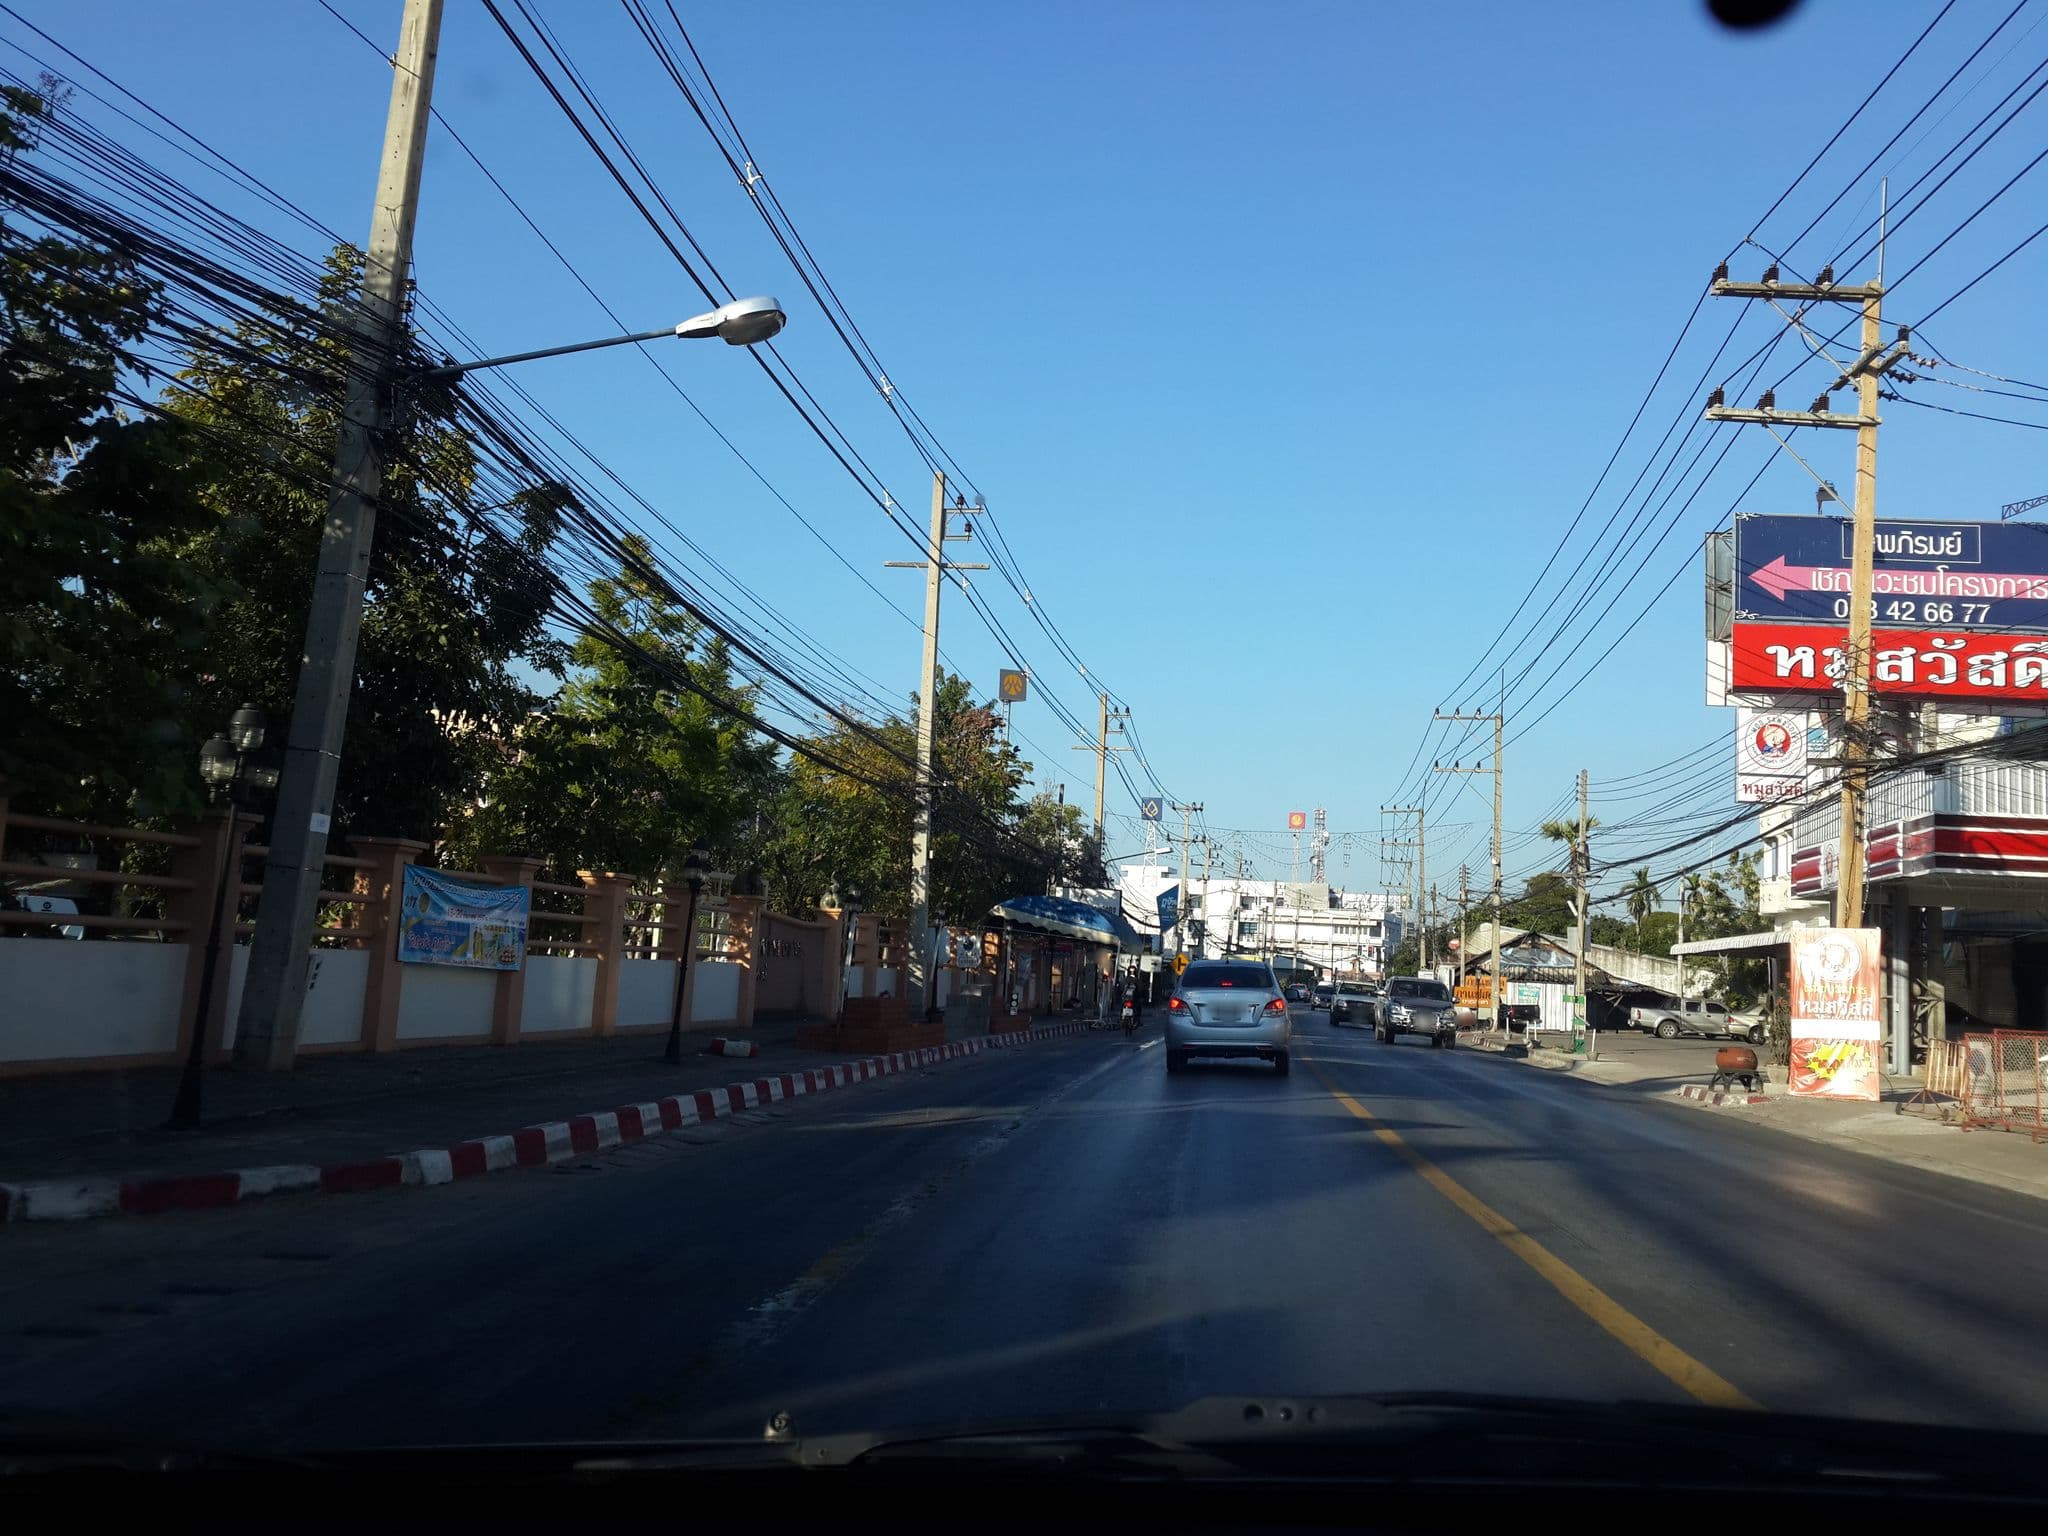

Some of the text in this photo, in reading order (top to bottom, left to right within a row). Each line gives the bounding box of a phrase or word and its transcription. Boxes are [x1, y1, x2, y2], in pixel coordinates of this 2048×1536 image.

[1834, 599, 1992, 623] 03 42 66 77
